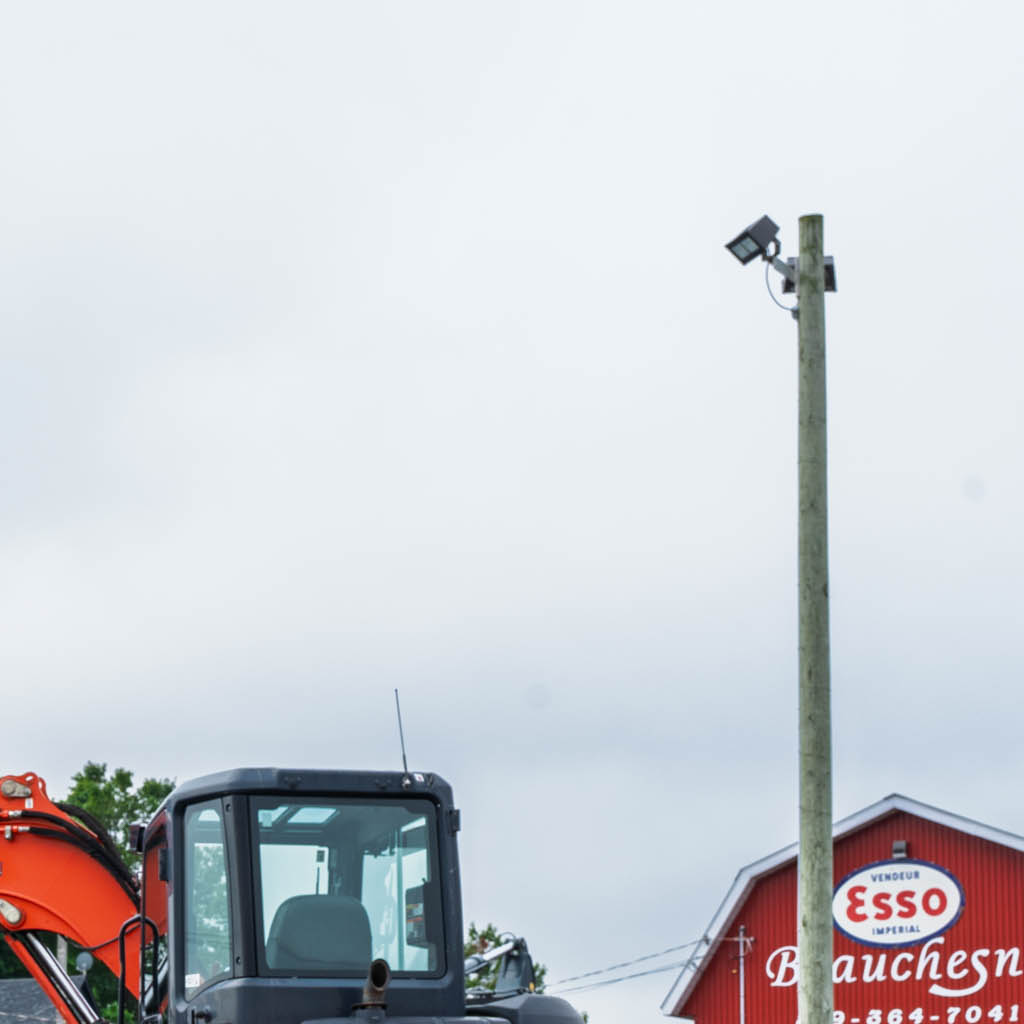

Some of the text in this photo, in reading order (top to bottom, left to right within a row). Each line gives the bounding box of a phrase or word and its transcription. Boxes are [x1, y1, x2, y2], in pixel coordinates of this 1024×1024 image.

[871, 870, 920, 882] VENDEUR
[872, 925, 921, 936] IMPERIAL
[766, 937, 1024, 998] Bauchesn
